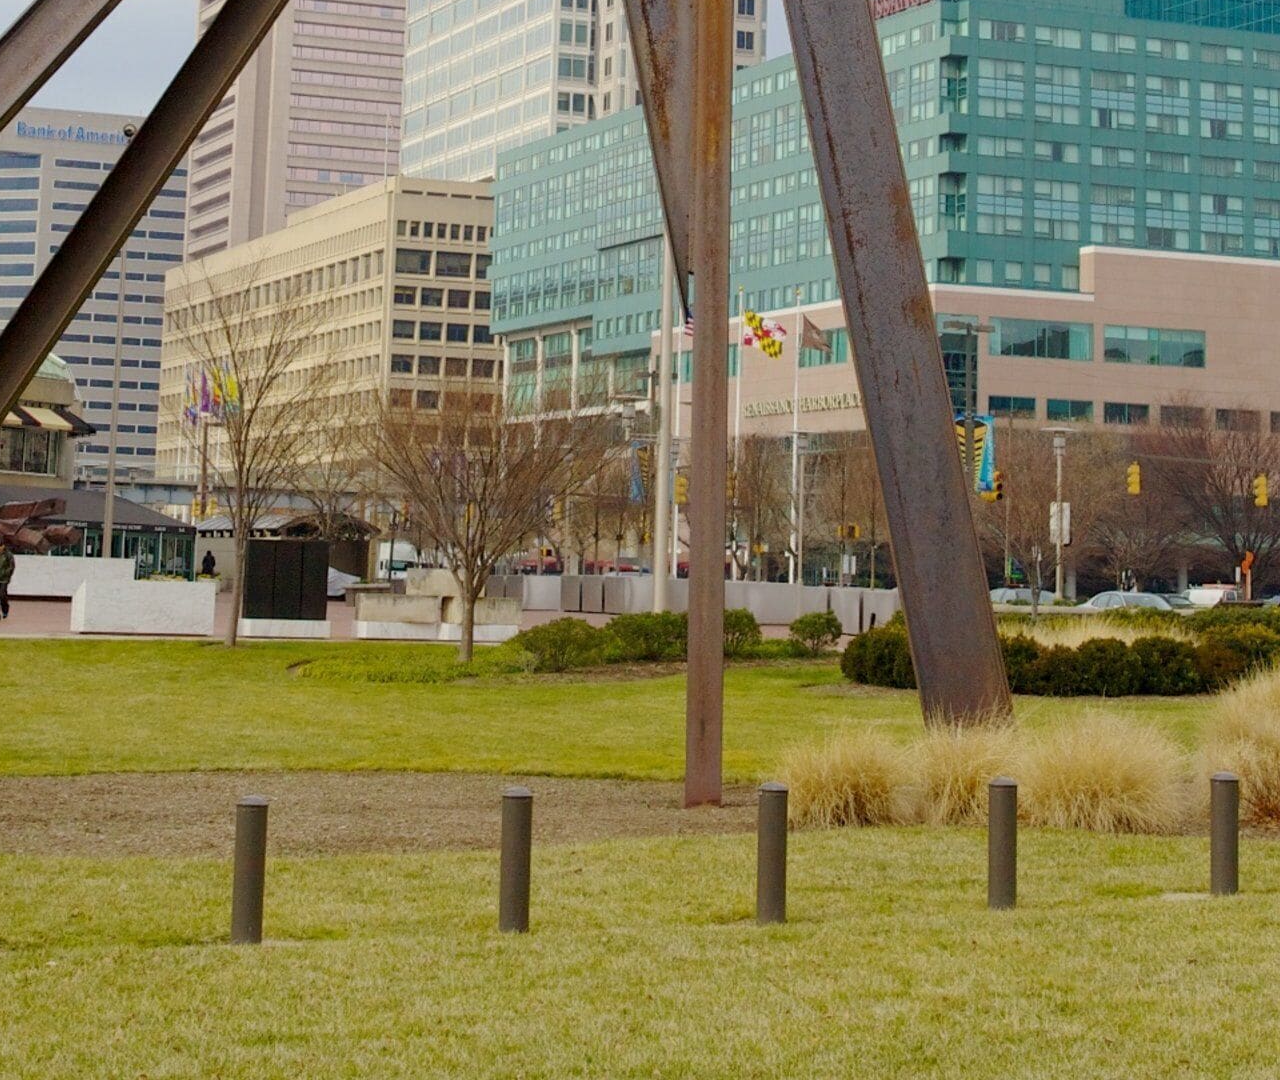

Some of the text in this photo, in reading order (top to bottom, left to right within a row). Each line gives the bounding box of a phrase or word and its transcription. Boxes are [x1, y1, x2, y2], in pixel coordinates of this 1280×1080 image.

[17, 121, 130, 145] Bank of Americ
[742, 399, 796, 417] RENAISSANC
